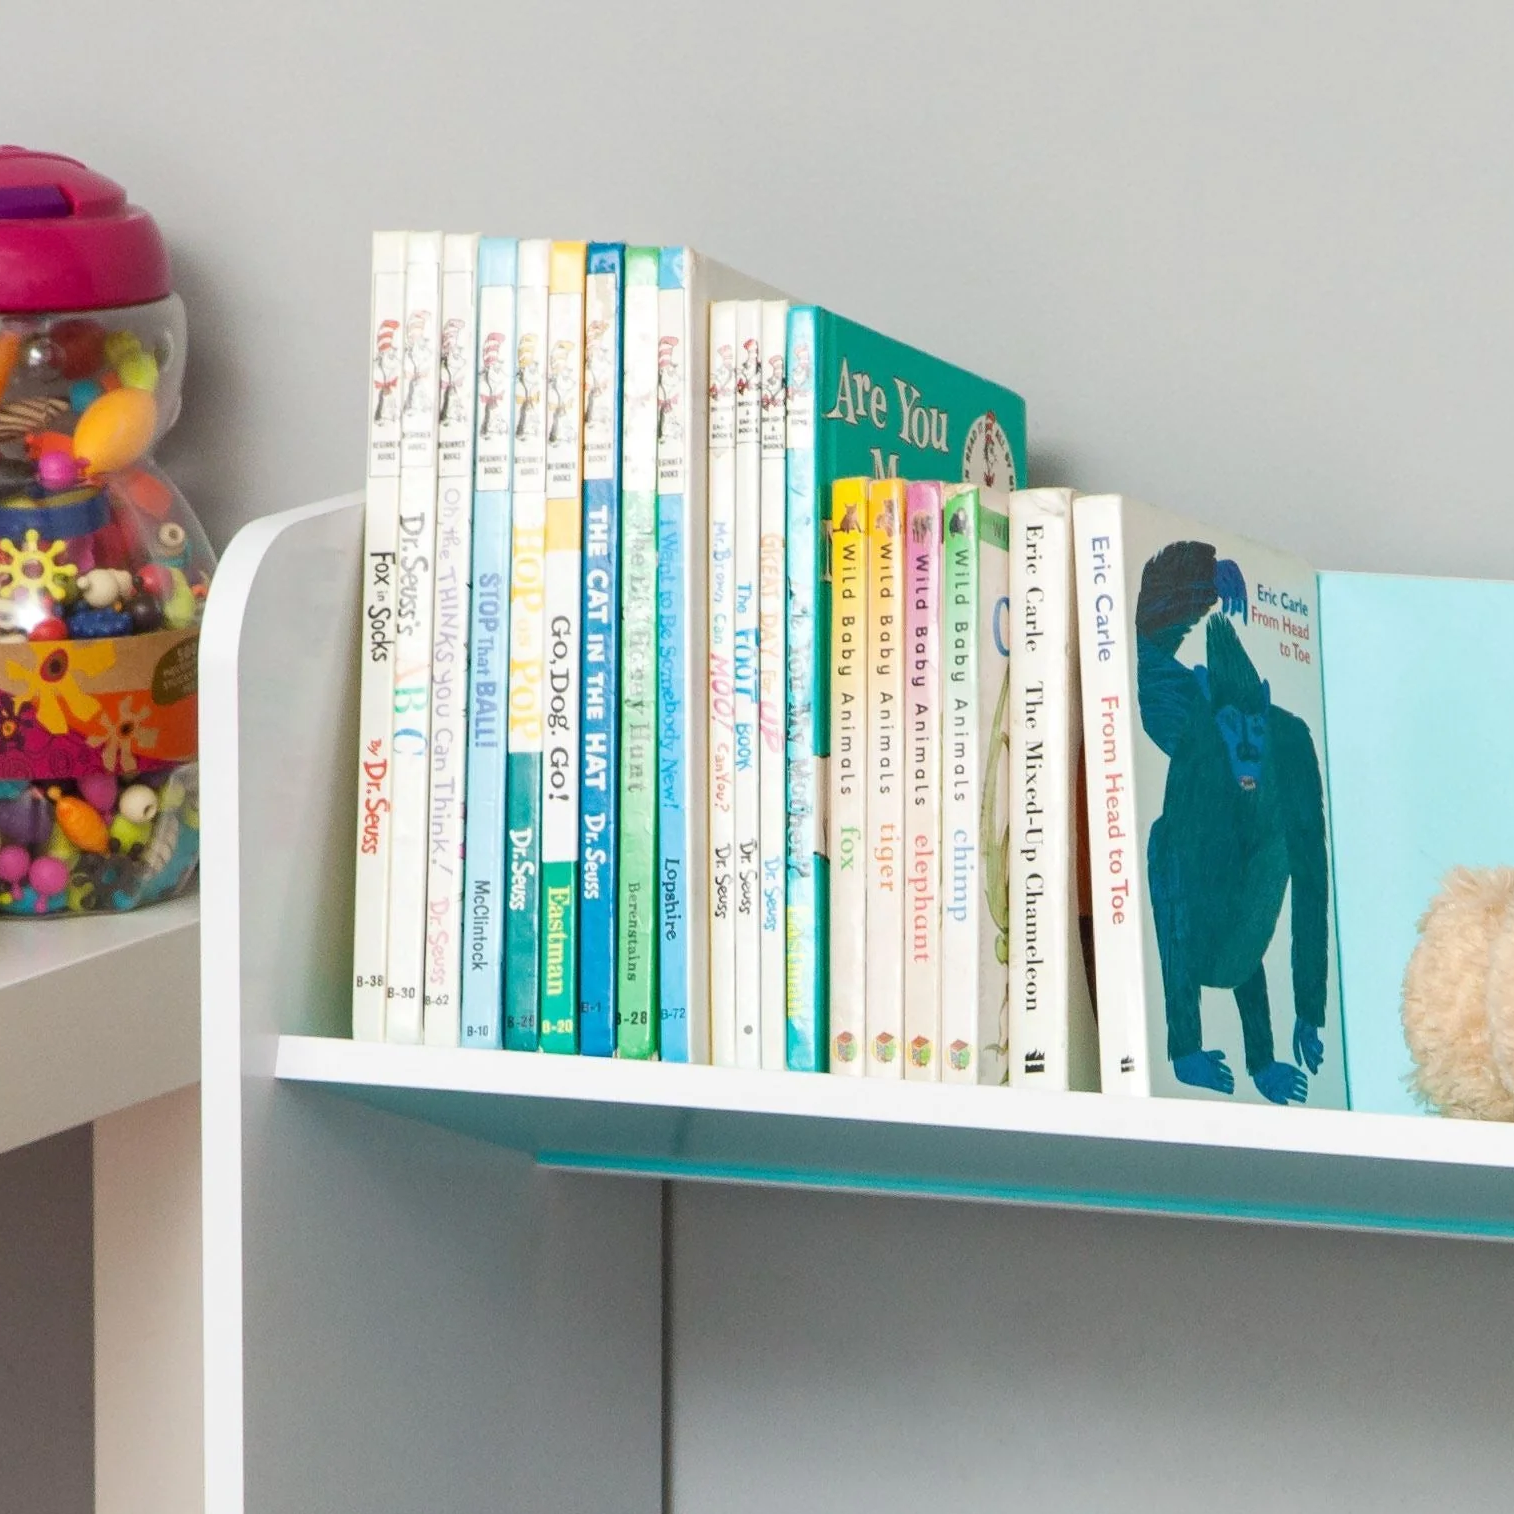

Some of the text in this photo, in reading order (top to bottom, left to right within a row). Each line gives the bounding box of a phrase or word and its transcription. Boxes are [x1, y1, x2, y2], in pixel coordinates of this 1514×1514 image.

[825, 357, 886, 429] Are
[893, 377, 949, 452] You
[368, 552, 396, 662] Fox in Socks
[436, 565, 460, 663] THINKS
[477, 573, 501, 631] STOP
[510, 528, 545, 740] HOP POP
[759, 532, 785, 753] GREAT DAY UP
[1251, 604, 1310, 641] From Head
[1257, 583, 1309, 617] Eric Carle
[584, 505, 610, 791] THE CAT IN THE HAT
[659, 530, 681, 809] Want to Be Somebody New!
[734, 582, 761, 772] The FOOT BOOK
[1279, 640, 1311, 665] to Toe
[474, 682, 500, 748] BALL!
[547, 616, 571, 801] Go, Dog. Go!
[710, 652, 735, 738] MOO!
[838, 544, 862, 871] Wild Baby Animals fox
[873, 543, 900, 892] Wild Baby Animals tiger
[946, 549, 975, 922] Wild Baby Animals chimp
[1091, 536, 1129, 925] Eric Carle From Head to Toe
[434, 729, 454, 771] Can
[628, 723, 651, 793] Hunt
[907, 555, 935, 963] Wild Baby Animals elephant
[1020, 525, 1046, 1012] Eric Carle The Mixed-Up Chameleon
[583, 847, 606, 900] Seuss
[664, 858, 682, 941] Lopshire
[714, 873, 735, 919] Seuss
[739, 870, 758, 915] Seuss
[763, 885, 783, 932] Seuss
[471, 880, 492, 971] McClintock
[546, 886, 571, 996] Eastman
[626, 882, 641, 982] Berenstains
[387, 987, 416, 999] B-30
[466, 1025, 489, 1037] B-10
[660, 1007, 686, 1020] B-72
